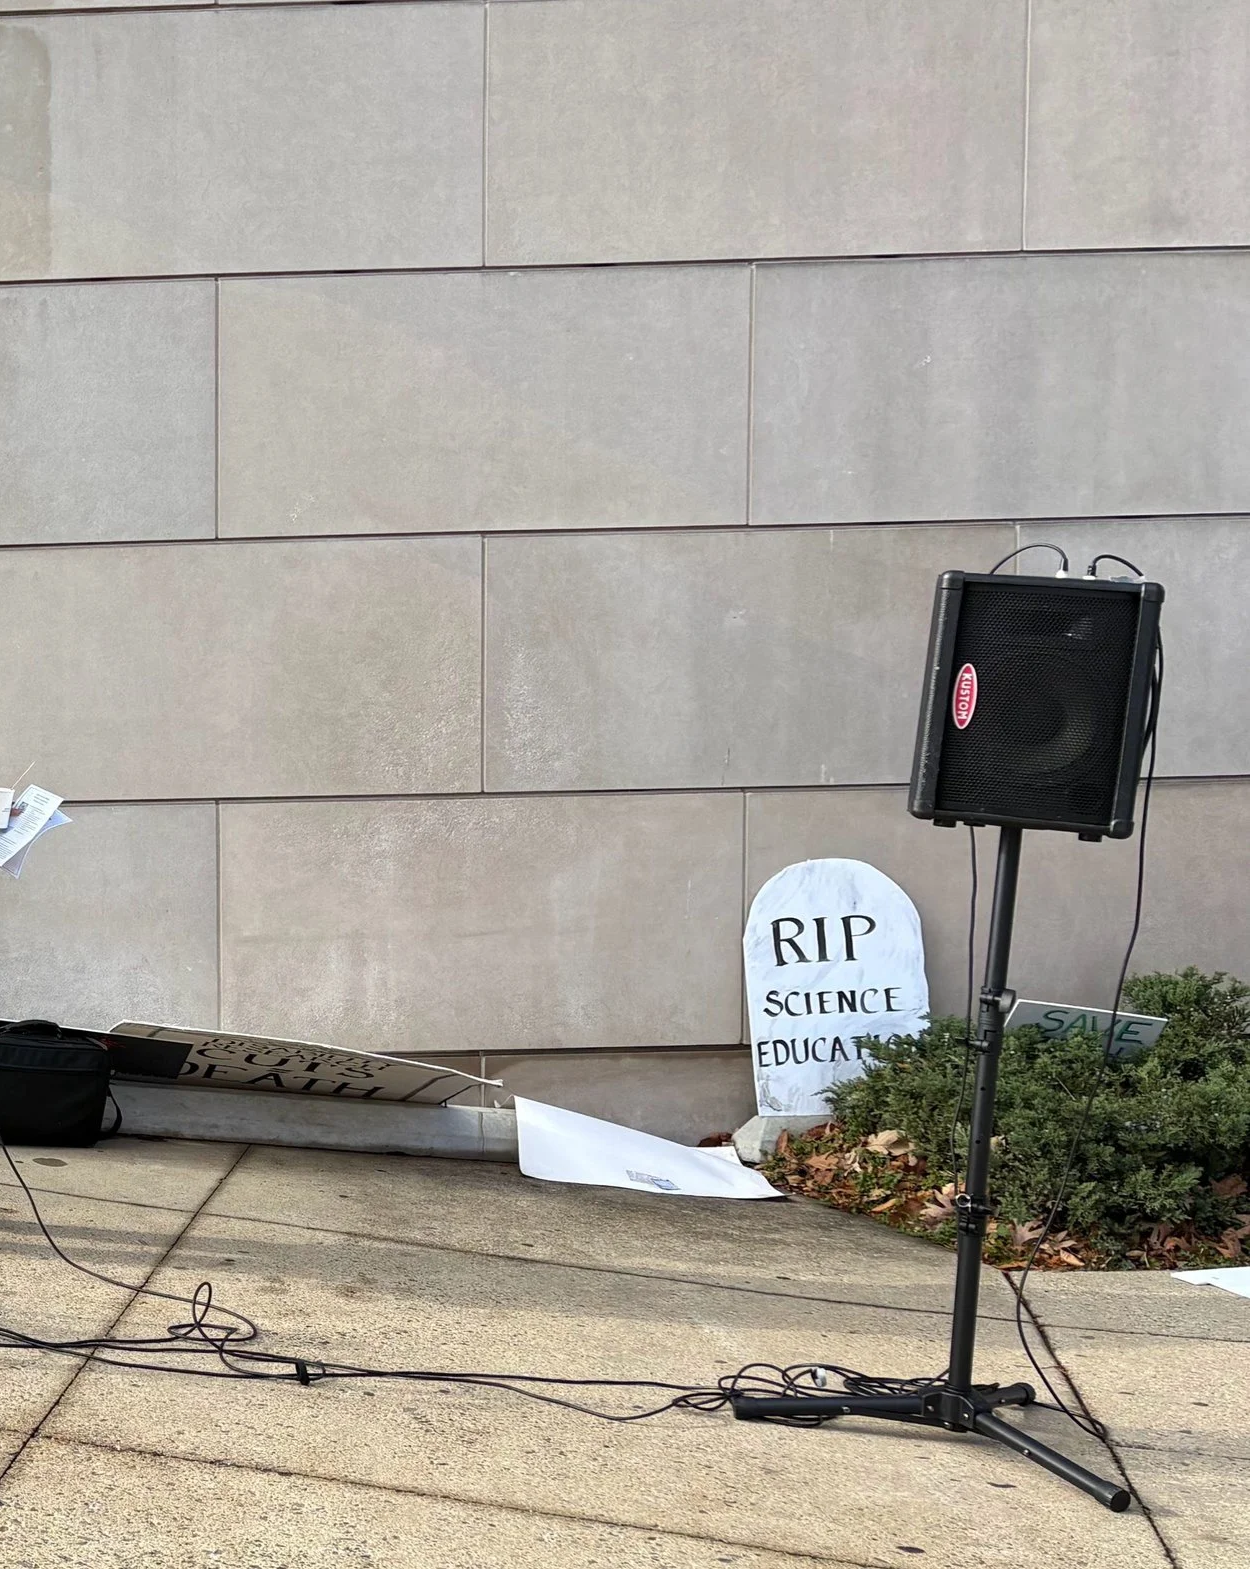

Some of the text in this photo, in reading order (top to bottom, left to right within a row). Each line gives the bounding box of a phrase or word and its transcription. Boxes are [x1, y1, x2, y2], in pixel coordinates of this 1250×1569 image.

[957, 673, 973, 720] KUSTOM
[770, 914, 877, 967] RIP
[763, 987, 905, 1018] SCIENCE
[1042, 1009, 1153, 1045] SAVE
[196, 1048, 375, 1079] CUTS
